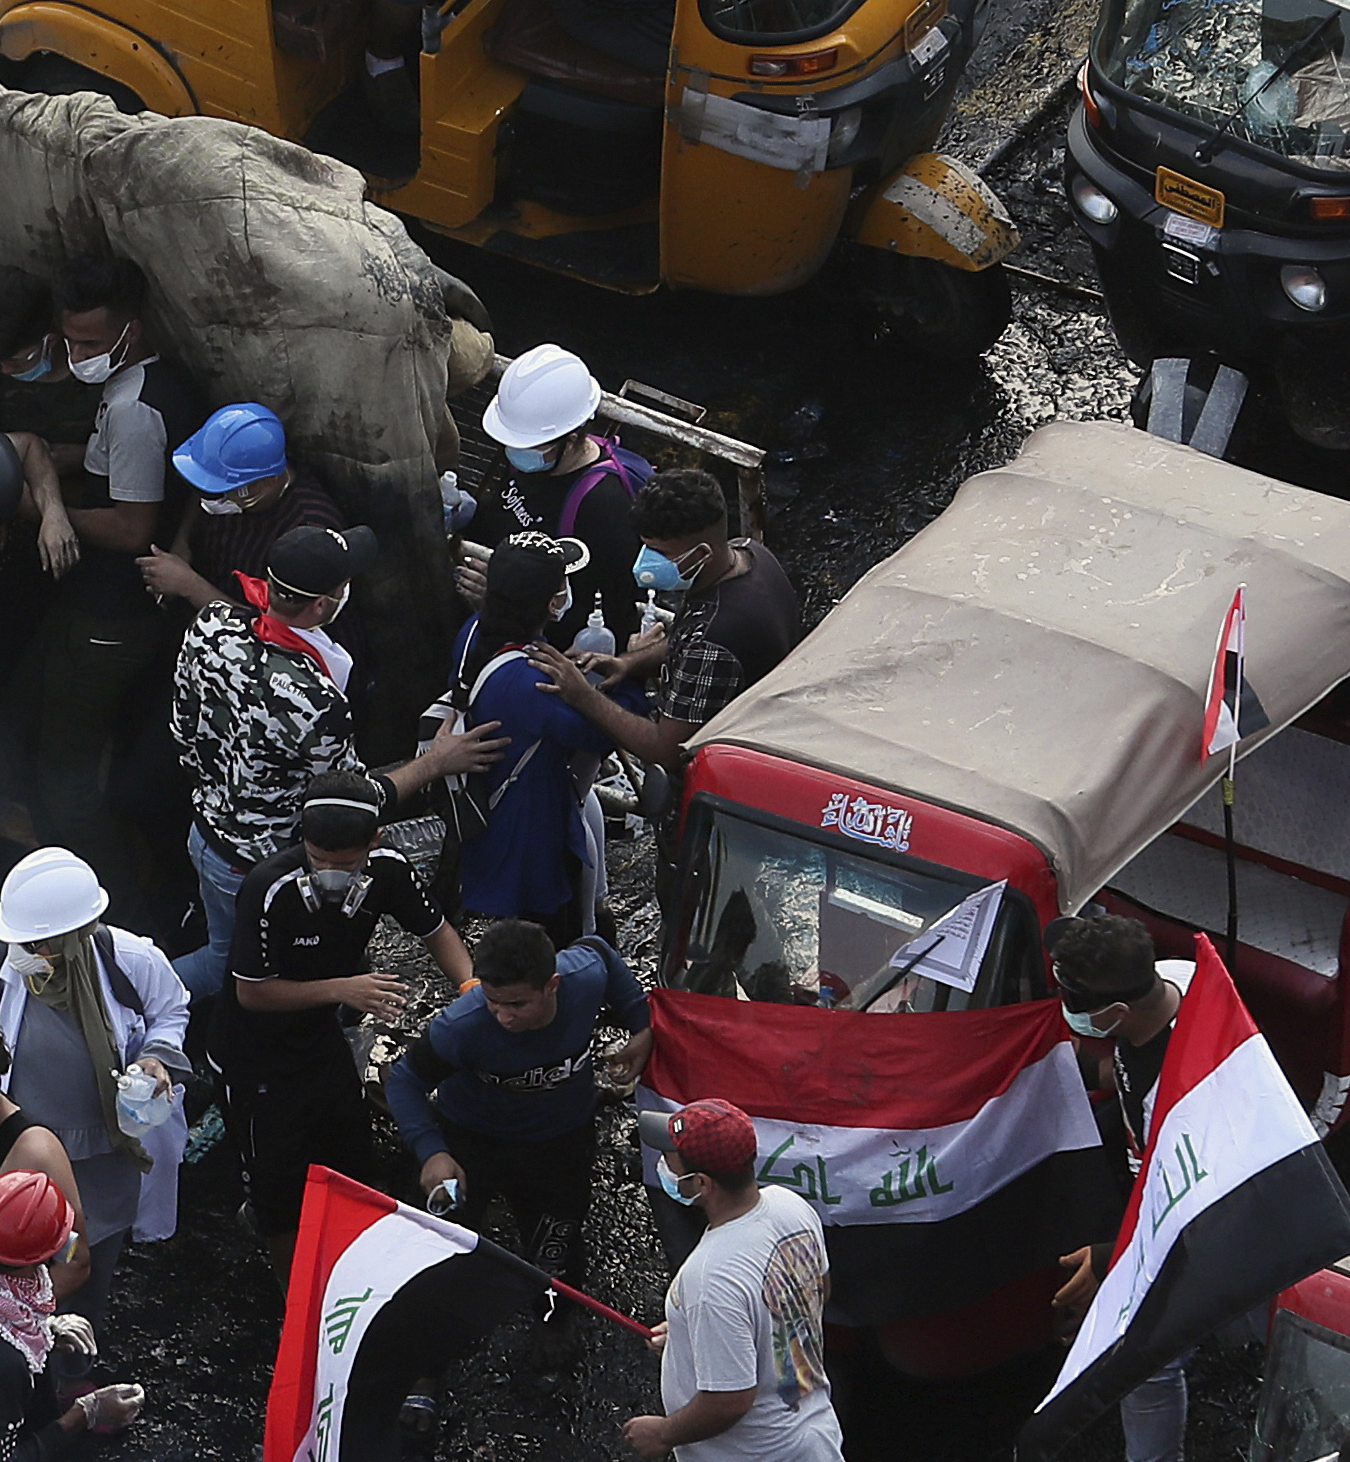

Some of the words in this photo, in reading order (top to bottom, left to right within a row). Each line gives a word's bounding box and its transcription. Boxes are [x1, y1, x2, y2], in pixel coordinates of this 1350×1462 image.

[292, 935, 320, 946] JAKO
[757, 1134, 842, 1205] اك
[869, 1140, 954, 1207] الله
